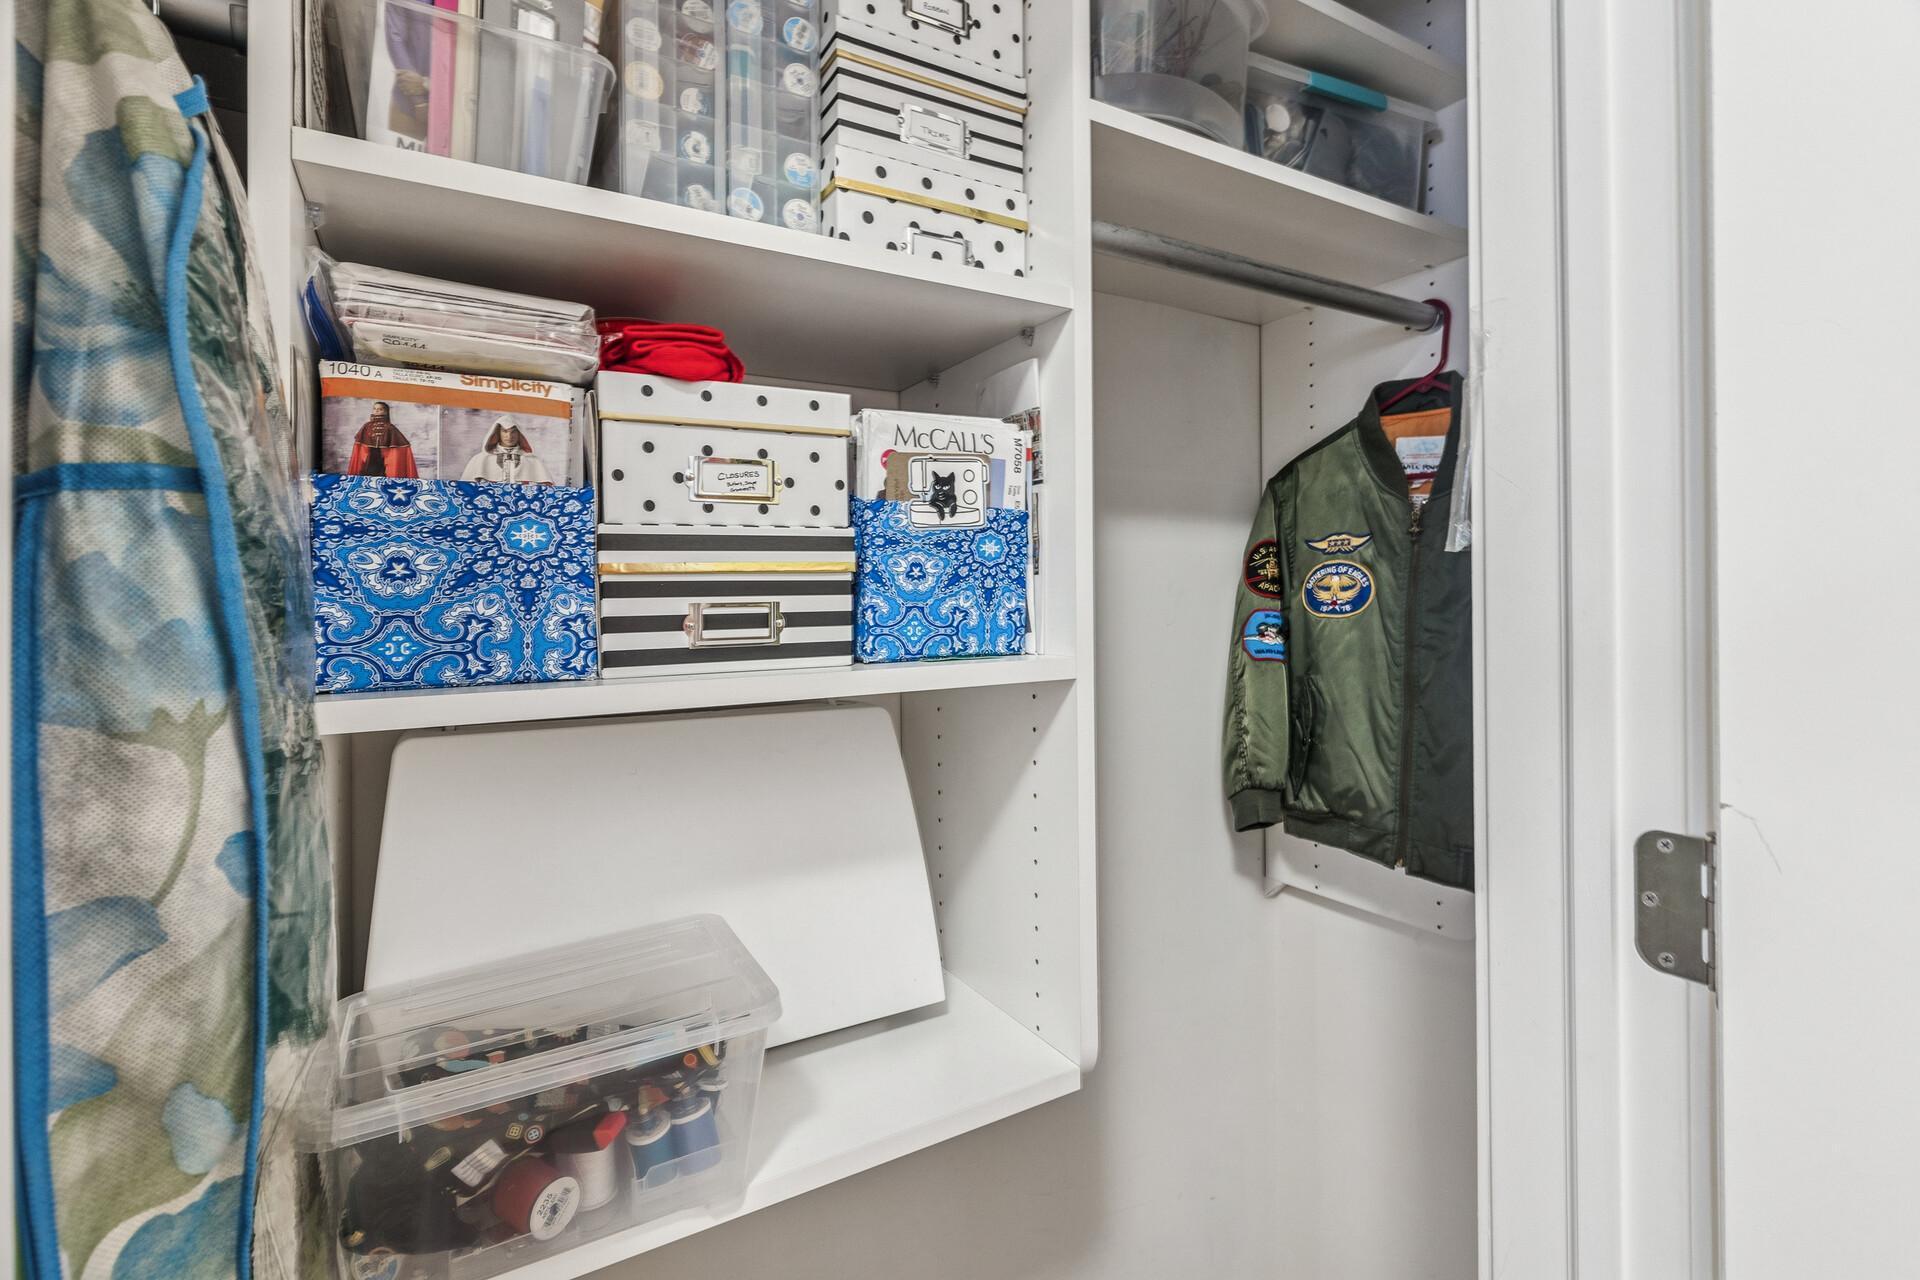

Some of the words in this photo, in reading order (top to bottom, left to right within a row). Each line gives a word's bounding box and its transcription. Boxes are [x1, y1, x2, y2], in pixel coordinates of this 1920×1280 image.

[329, 362, 371, 377] 1040
[374, 370, 383, 378] A
[460, 374, 552, 397] Simplicity
[894, 424, 995, 454] McCALL'S
[1013, 437, 1023, 474] M7058
[717, 470, 760, 481] CLOSURES
[1306, 565, 1337, 589] GATHERING
[1337, 565, 1348, 574] OF
[1347, 567, 1370, 587] EAGLES
